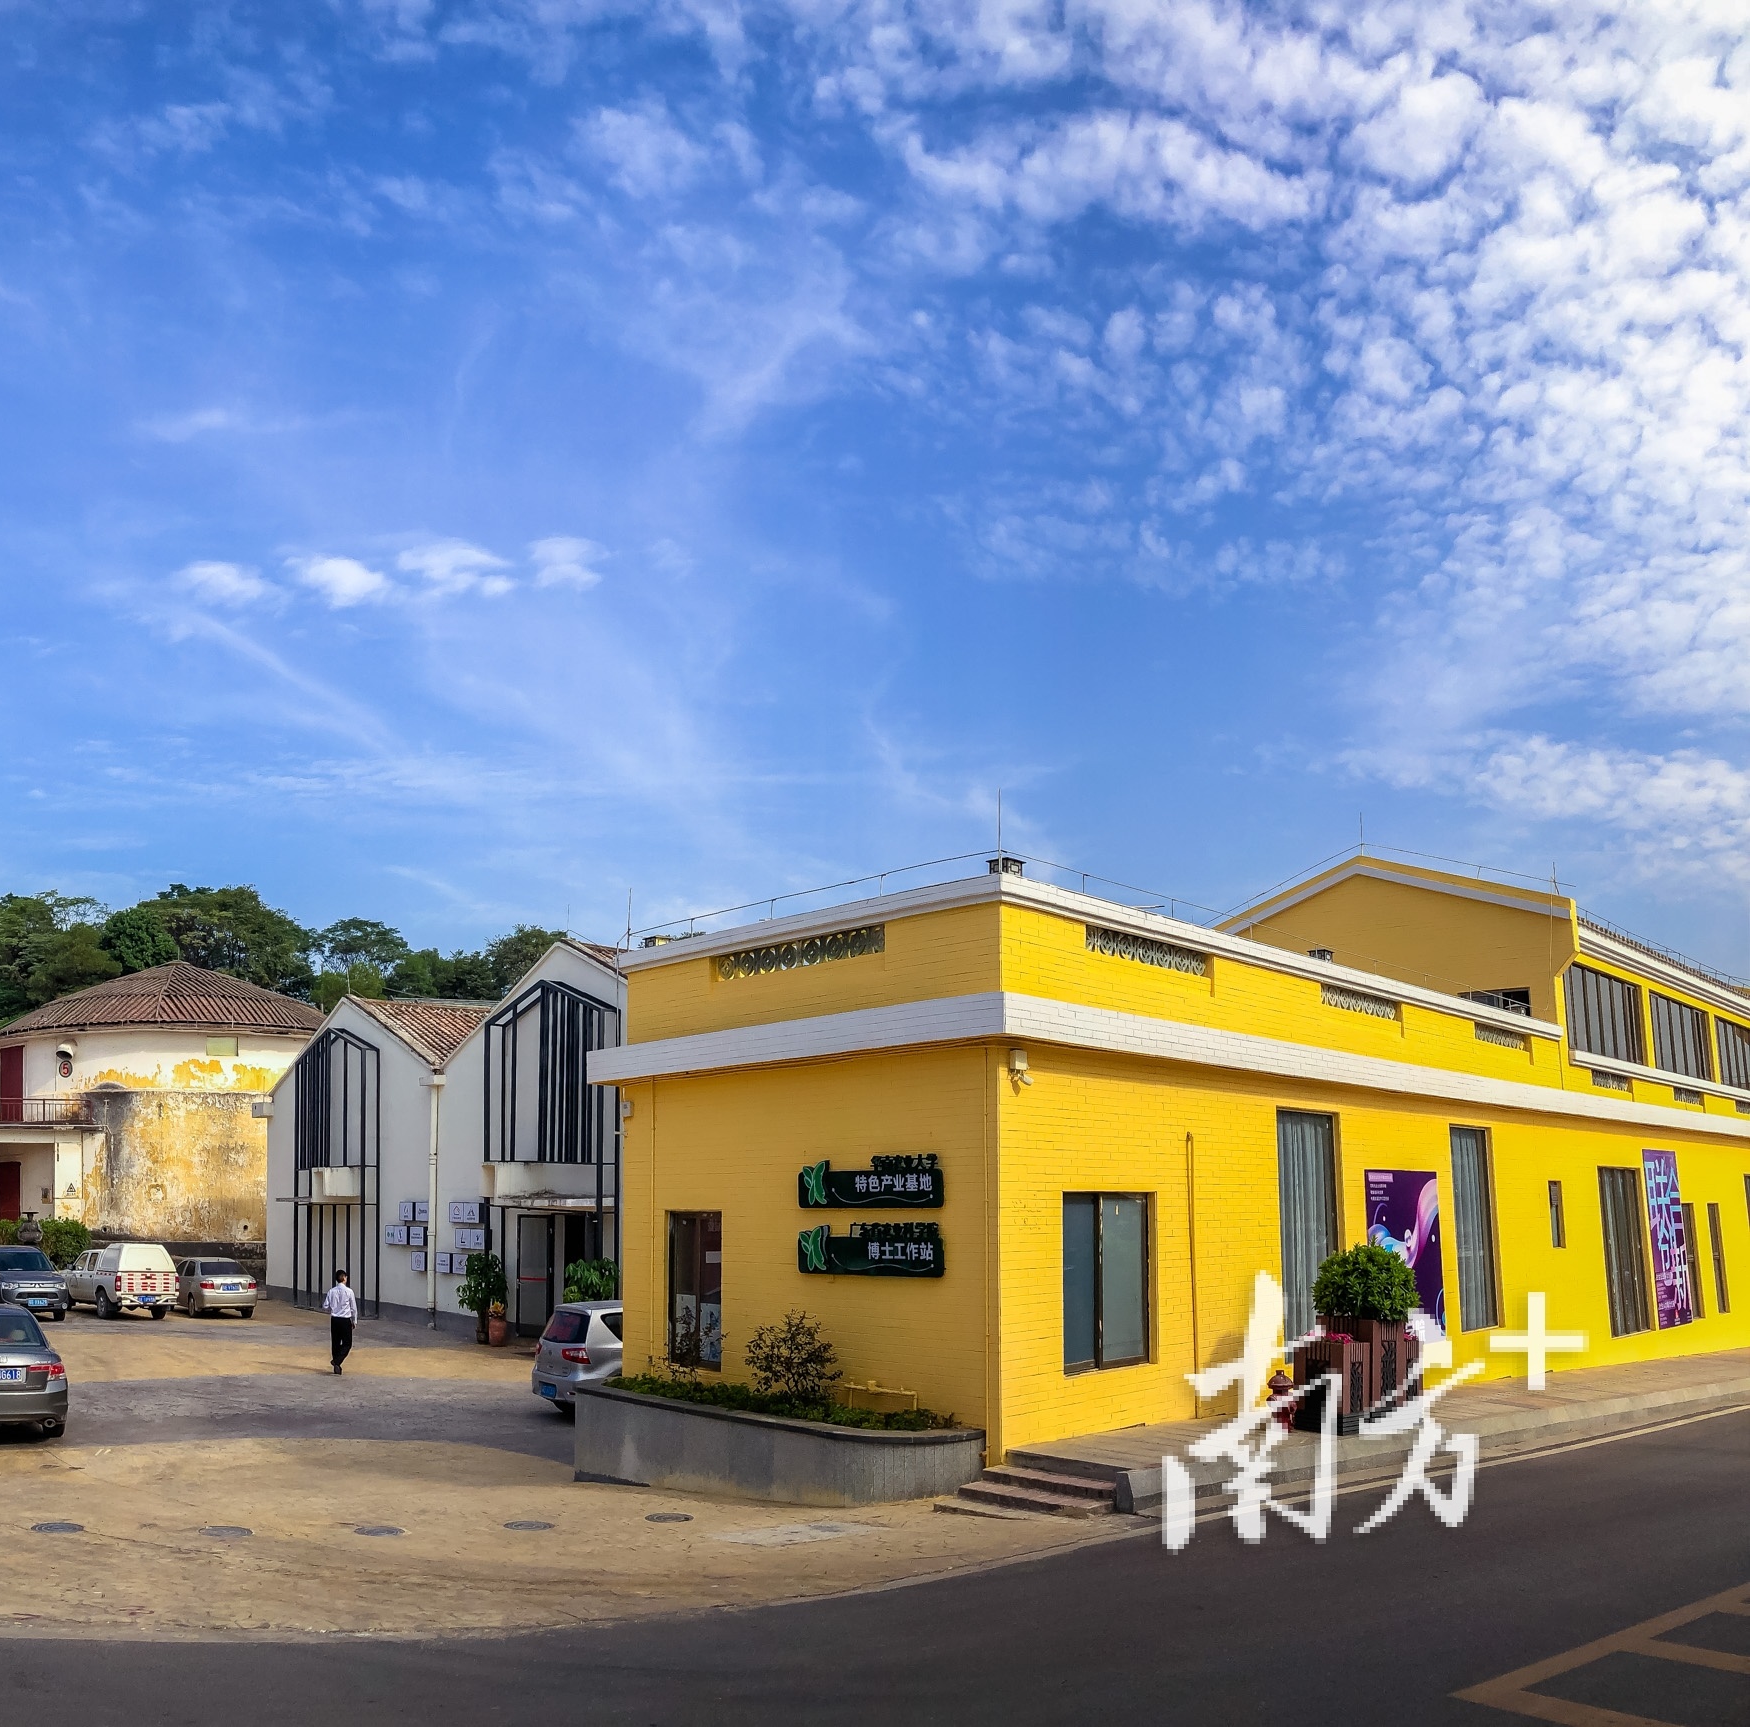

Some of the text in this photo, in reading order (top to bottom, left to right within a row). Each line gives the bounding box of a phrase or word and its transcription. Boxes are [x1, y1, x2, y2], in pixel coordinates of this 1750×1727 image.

[62, 1063, 69, 1075] 5
[854, 1173, 933, 1193] 特色产业基地
[867, 1241, 934, 1261] 博士工作站
